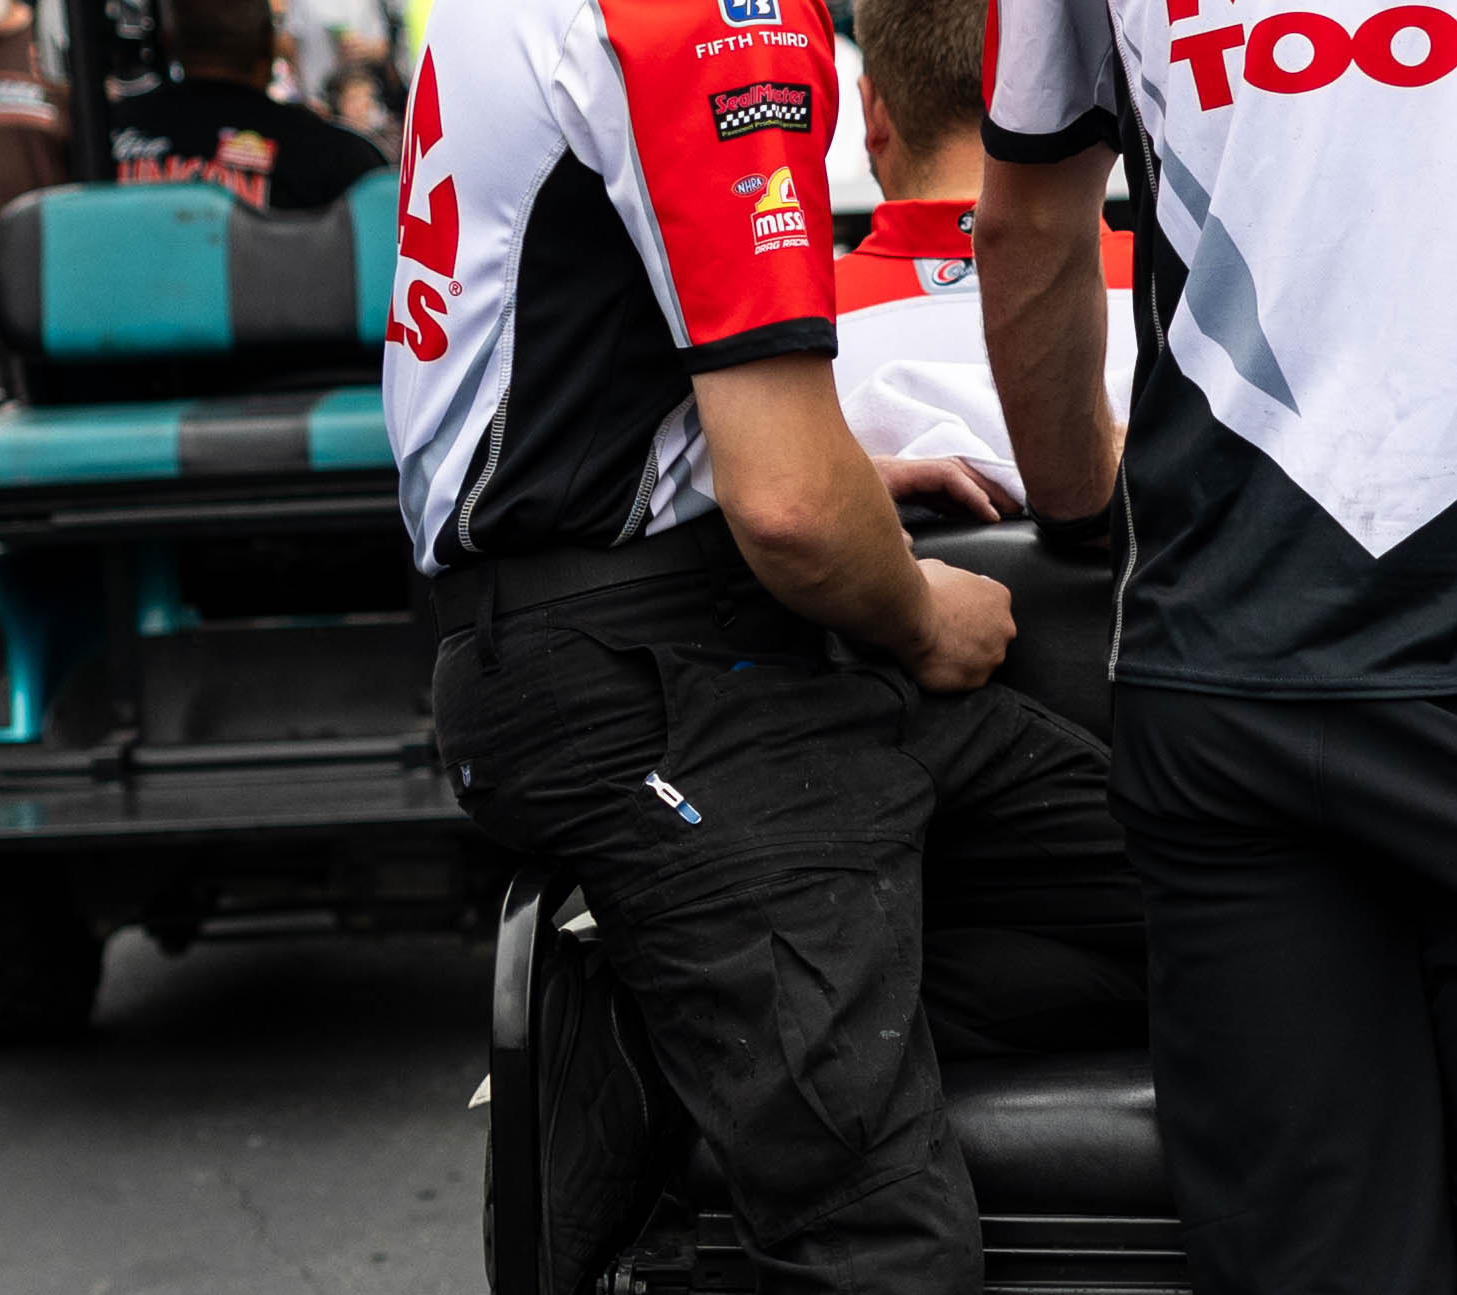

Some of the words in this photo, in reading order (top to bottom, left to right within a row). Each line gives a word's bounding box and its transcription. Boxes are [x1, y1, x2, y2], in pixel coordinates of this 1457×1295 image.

[695, 32, 754, 59] FIFTH
[758, 30, 809, 48] THIRD
[737, 177, 762, 194] NHRA
